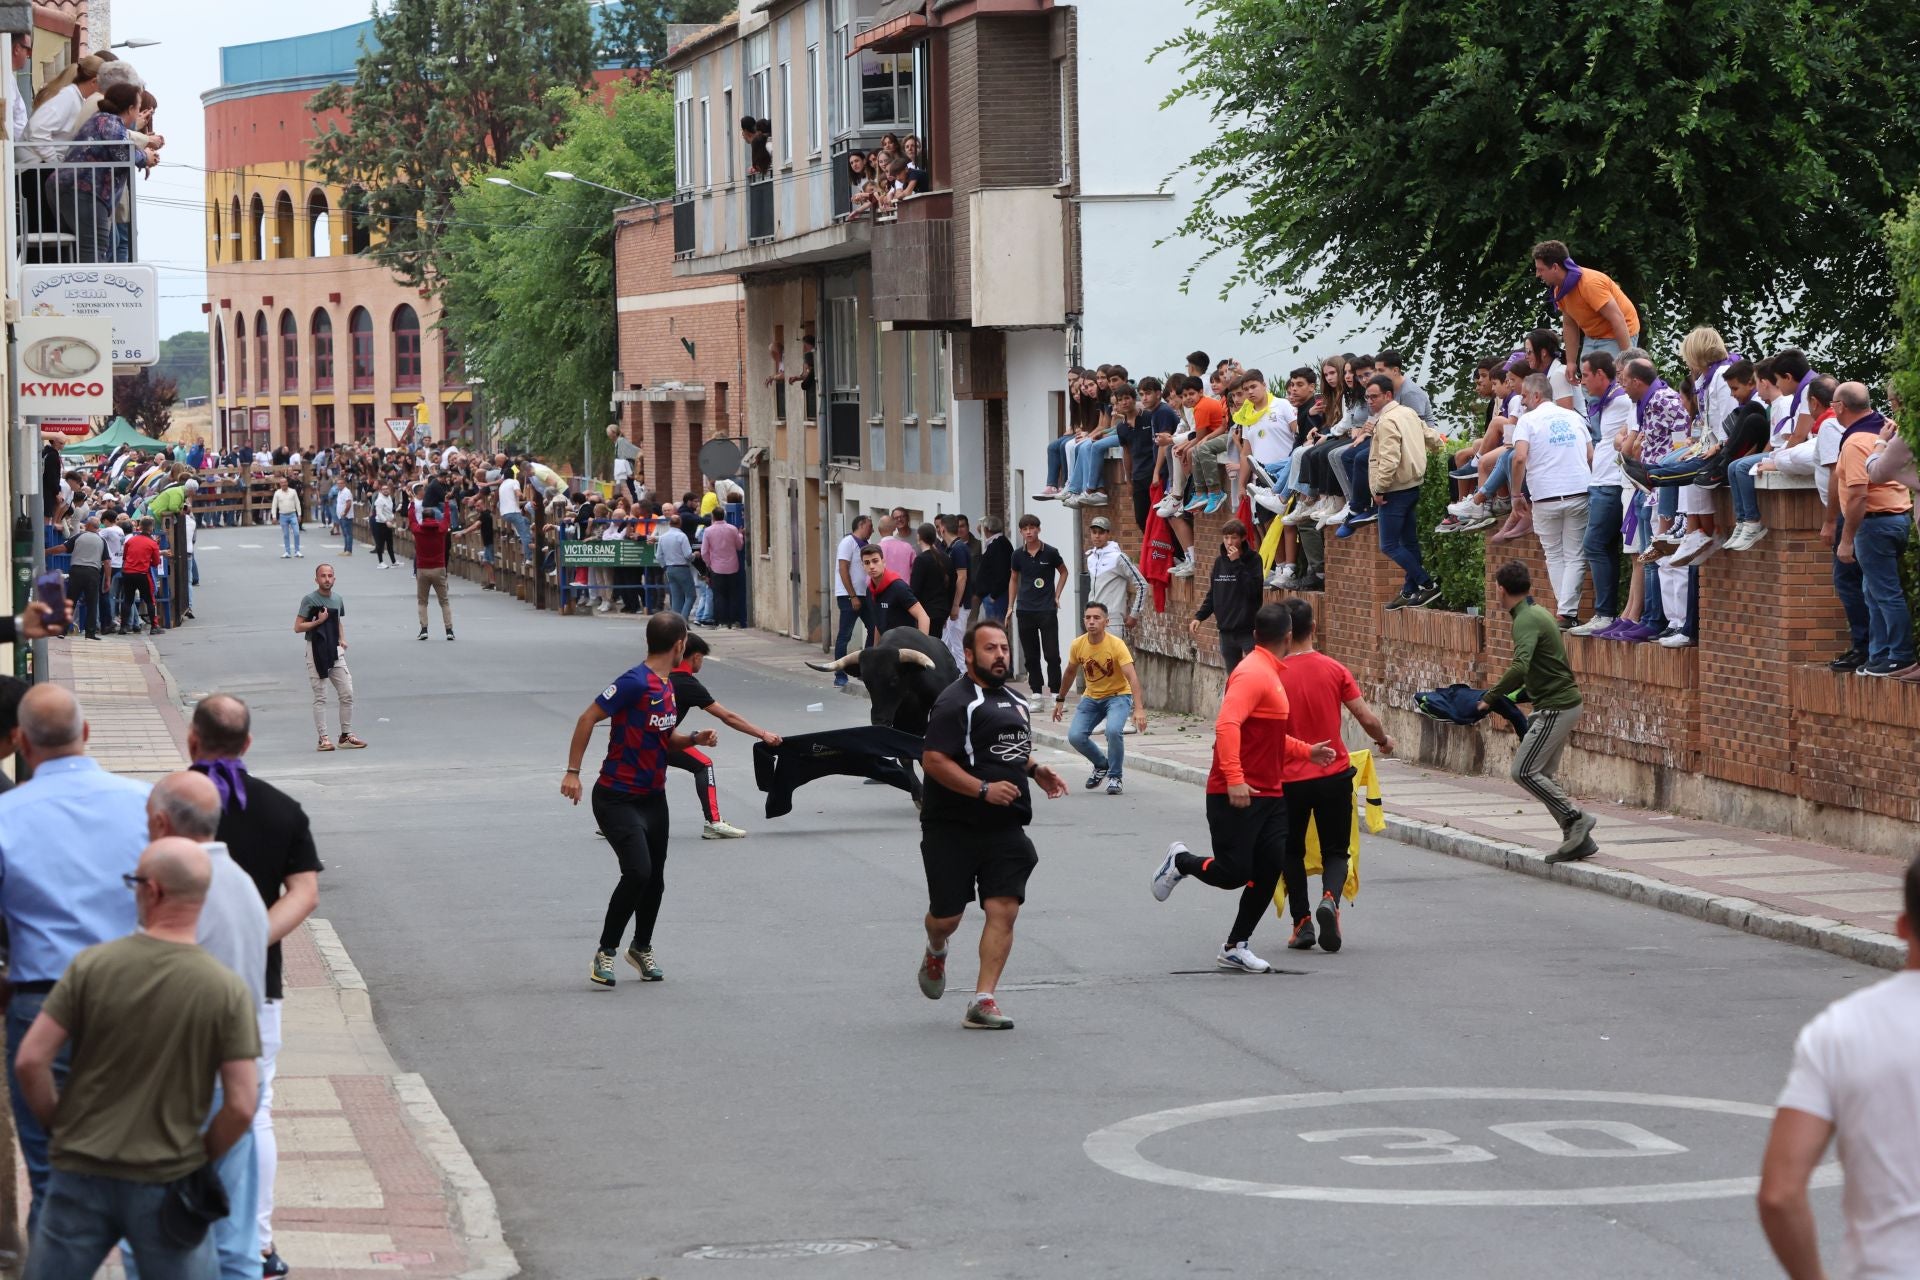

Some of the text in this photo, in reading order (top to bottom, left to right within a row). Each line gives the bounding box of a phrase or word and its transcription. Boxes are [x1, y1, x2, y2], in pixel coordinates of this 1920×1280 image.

[32, 272, 144, 299] MOTOS 2001
[125, 350, 142, 359] 86
[21, 382, 104, 397] KYMCO
[564, 544, 616, 554] VICTOR SANZ
[649, 713, 677, 728] Rakute
[1300, 1119, 1691, 1166] 30
